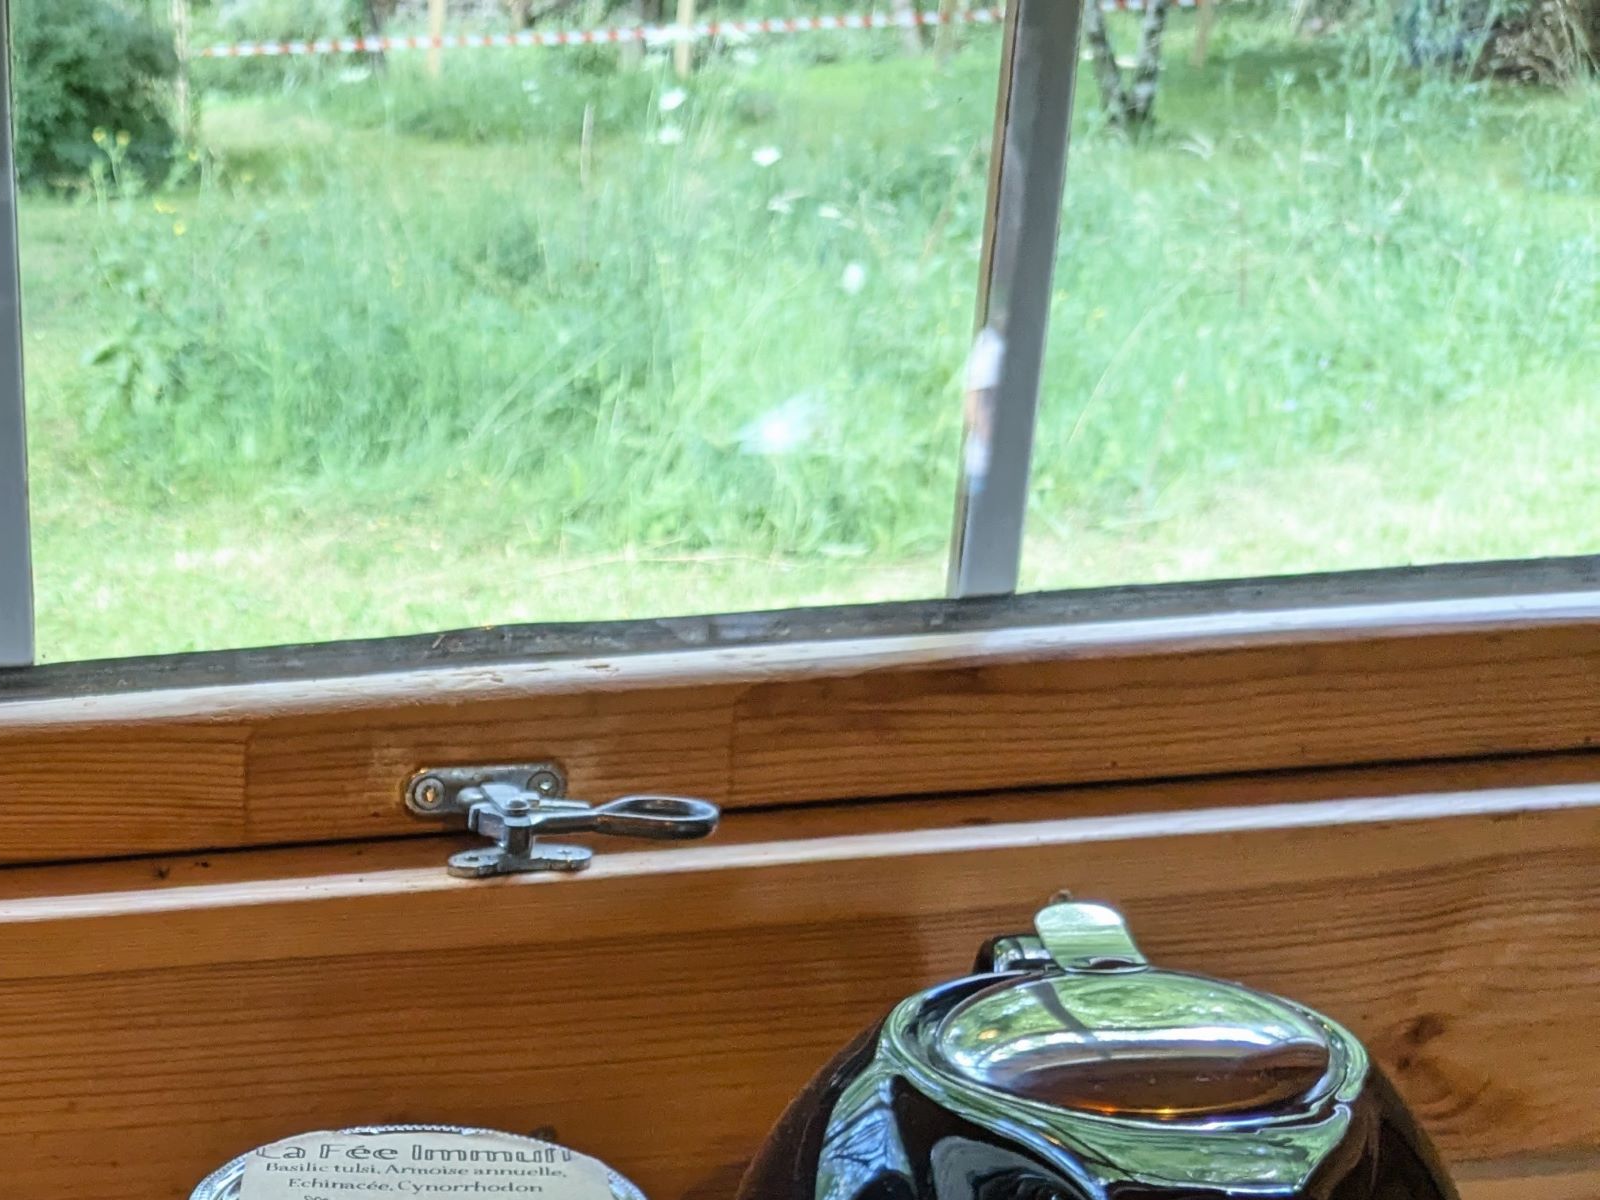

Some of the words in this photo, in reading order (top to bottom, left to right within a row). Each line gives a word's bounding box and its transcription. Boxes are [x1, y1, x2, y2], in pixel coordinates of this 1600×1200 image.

[255, 1145, 307, 1160] La
[319, 1143, 399, 1161] Fée
[266, 1162, 330, 1172] Basilic
[385, 1163, 469, 1175] Armoise
[397, 1180, 543, 1195] Cynorrhodon
